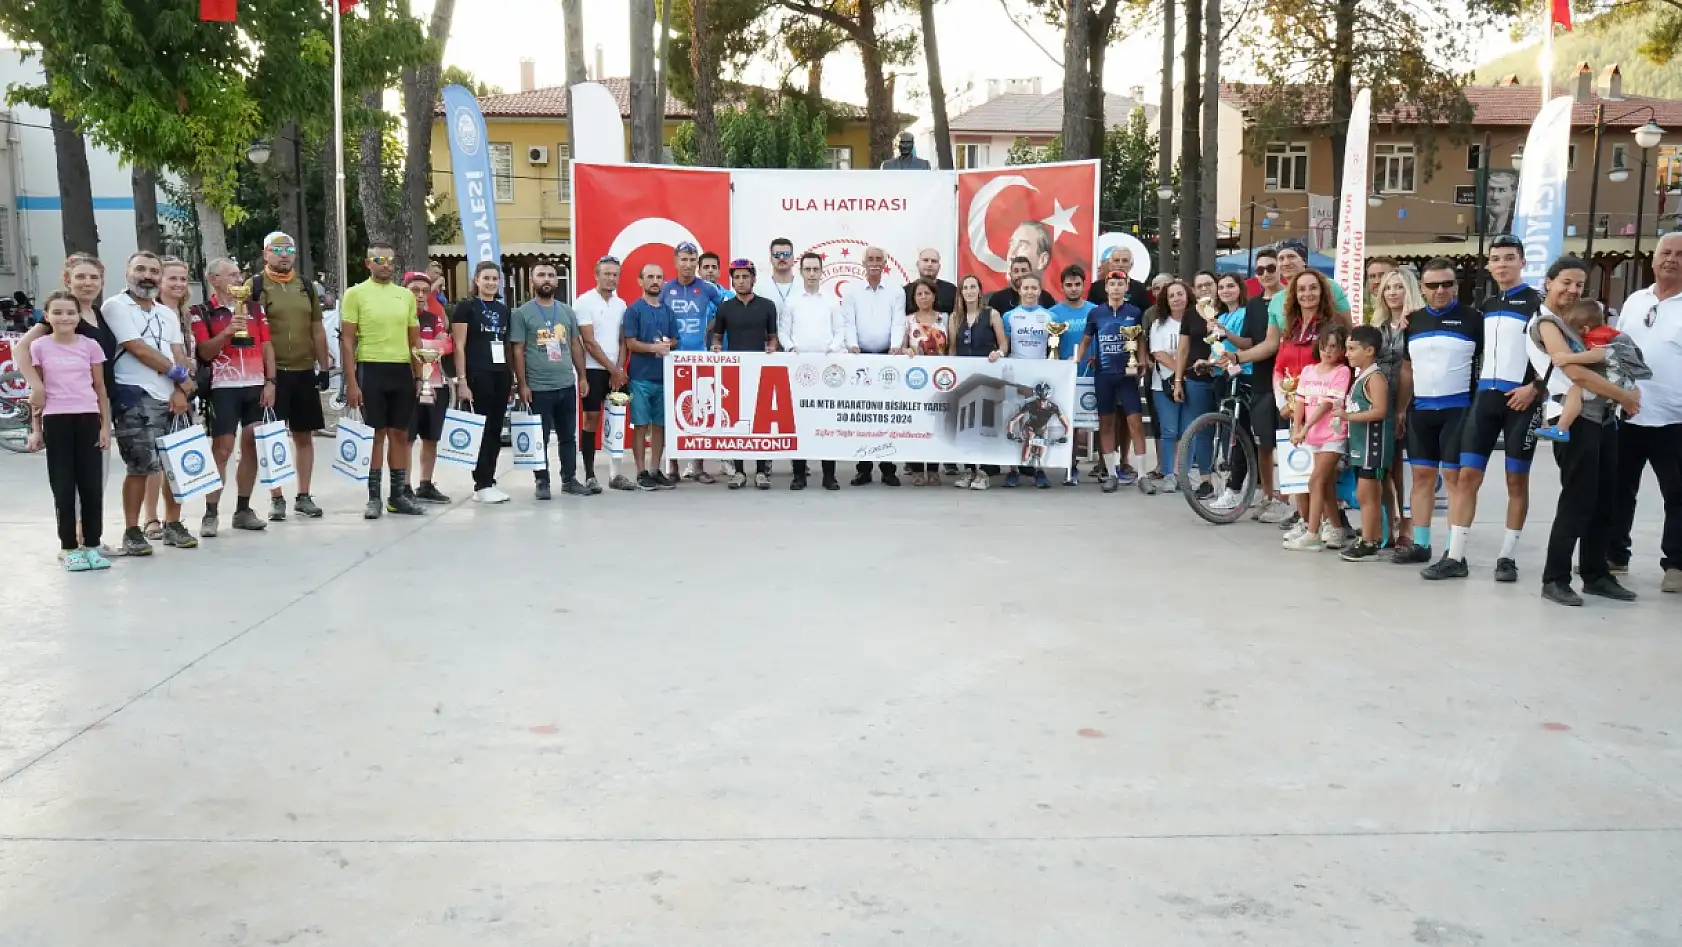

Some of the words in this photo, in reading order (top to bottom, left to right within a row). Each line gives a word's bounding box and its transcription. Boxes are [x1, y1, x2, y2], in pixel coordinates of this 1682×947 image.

[782, 198, 818, 211] ULA
[824, 198, 907, 211] HATIRASI
[832, 265, 866, 276] GENÇLİ
[674, 354, 704, 364] ZAFER
[707, 355, 741, 364] KUPASI
[673, 365, 797, 434] ULA
[799, 398, 816, 408] ULA
[817, 399, 835, 409] MTB
[837, 399, 884, 411] MARATONU
[836, 412, 849, 422] 30
[850, 411, 889, 423] AĞUSTOS
[891, 414, 913, 424] 2024
[684, 437, 712, 449] MTB
[716, 437, 791, 450] MARATONU
